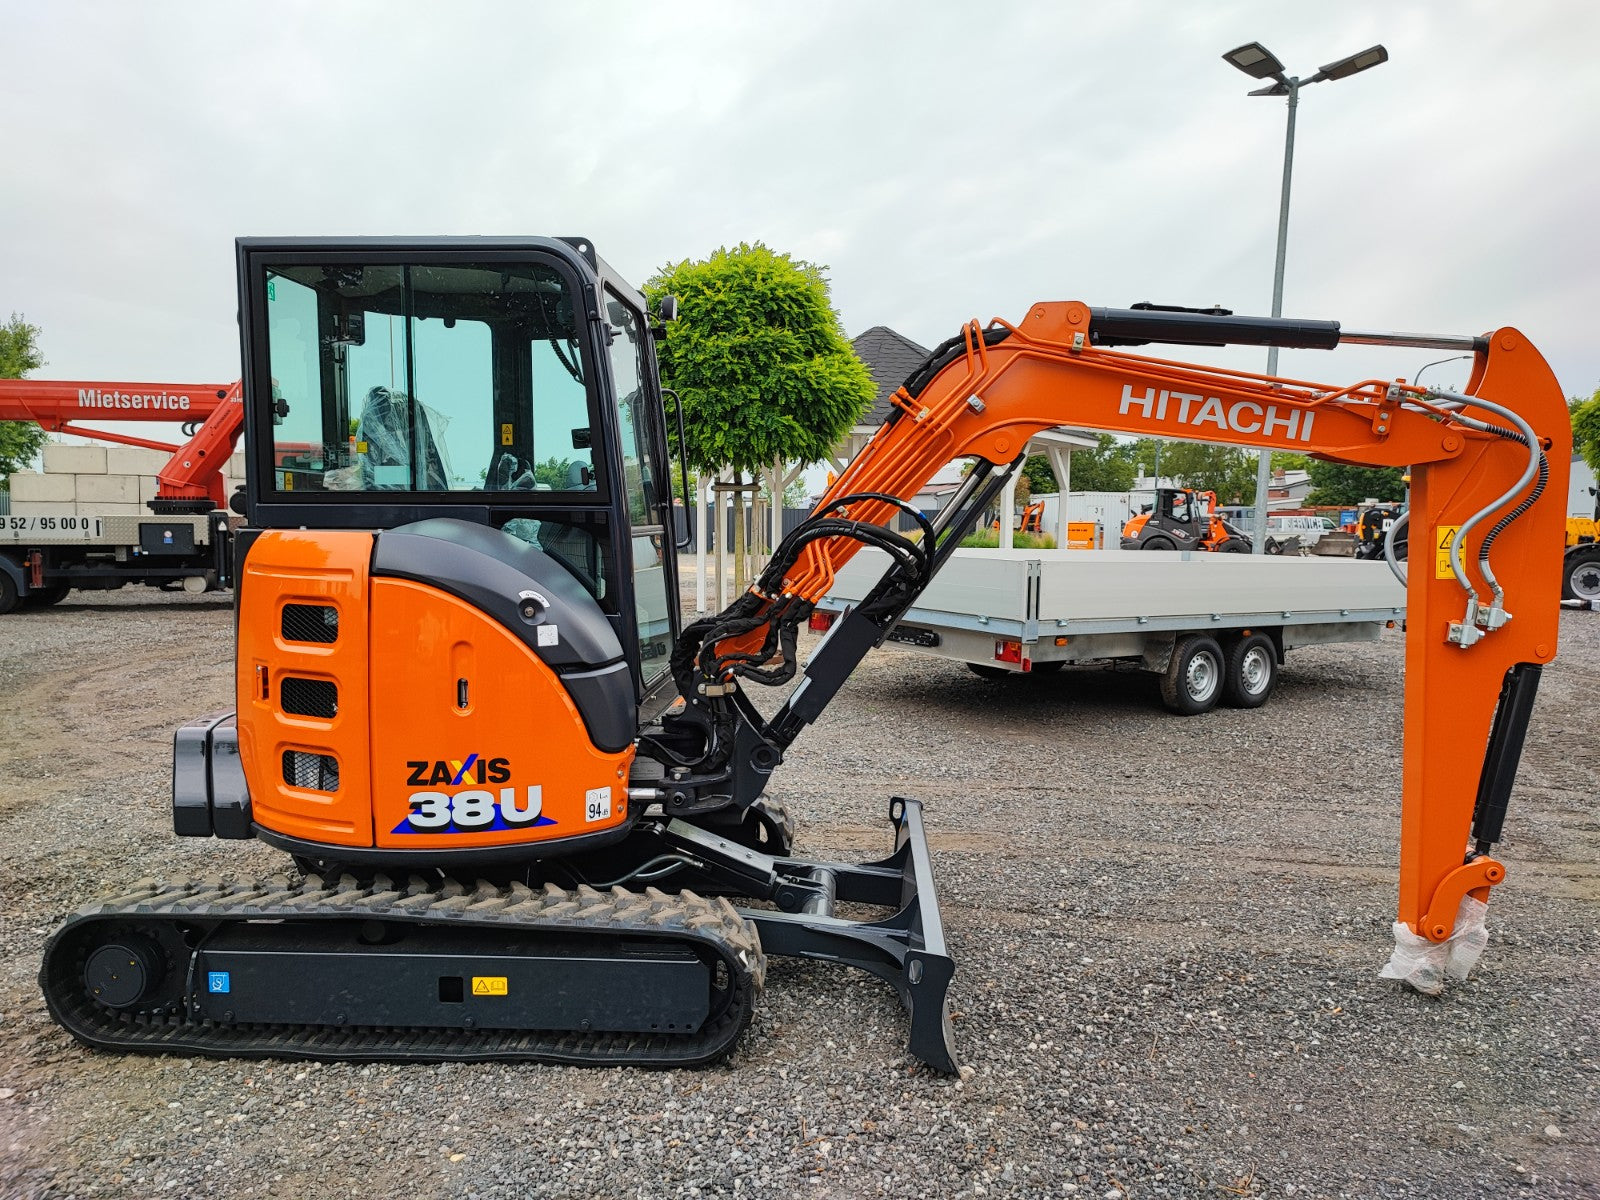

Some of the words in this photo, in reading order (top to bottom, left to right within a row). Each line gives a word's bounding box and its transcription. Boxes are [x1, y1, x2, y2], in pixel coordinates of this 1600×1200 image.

[78, 389, 191, 410] Mietservice
[1119, 384, 1315, 442] HITACHI
[10, 517, 26, 530] 52
[30, 517, 36, 531] /
[40, 517, 56, 530] 95
[60, 517, 77, 530] 00
[81, 517, 89, 530] 0
[407, 754, 511, 786] ZAXIS
[408, 785, 542, 832] 38U
[588, 802, 602, 819] 94
